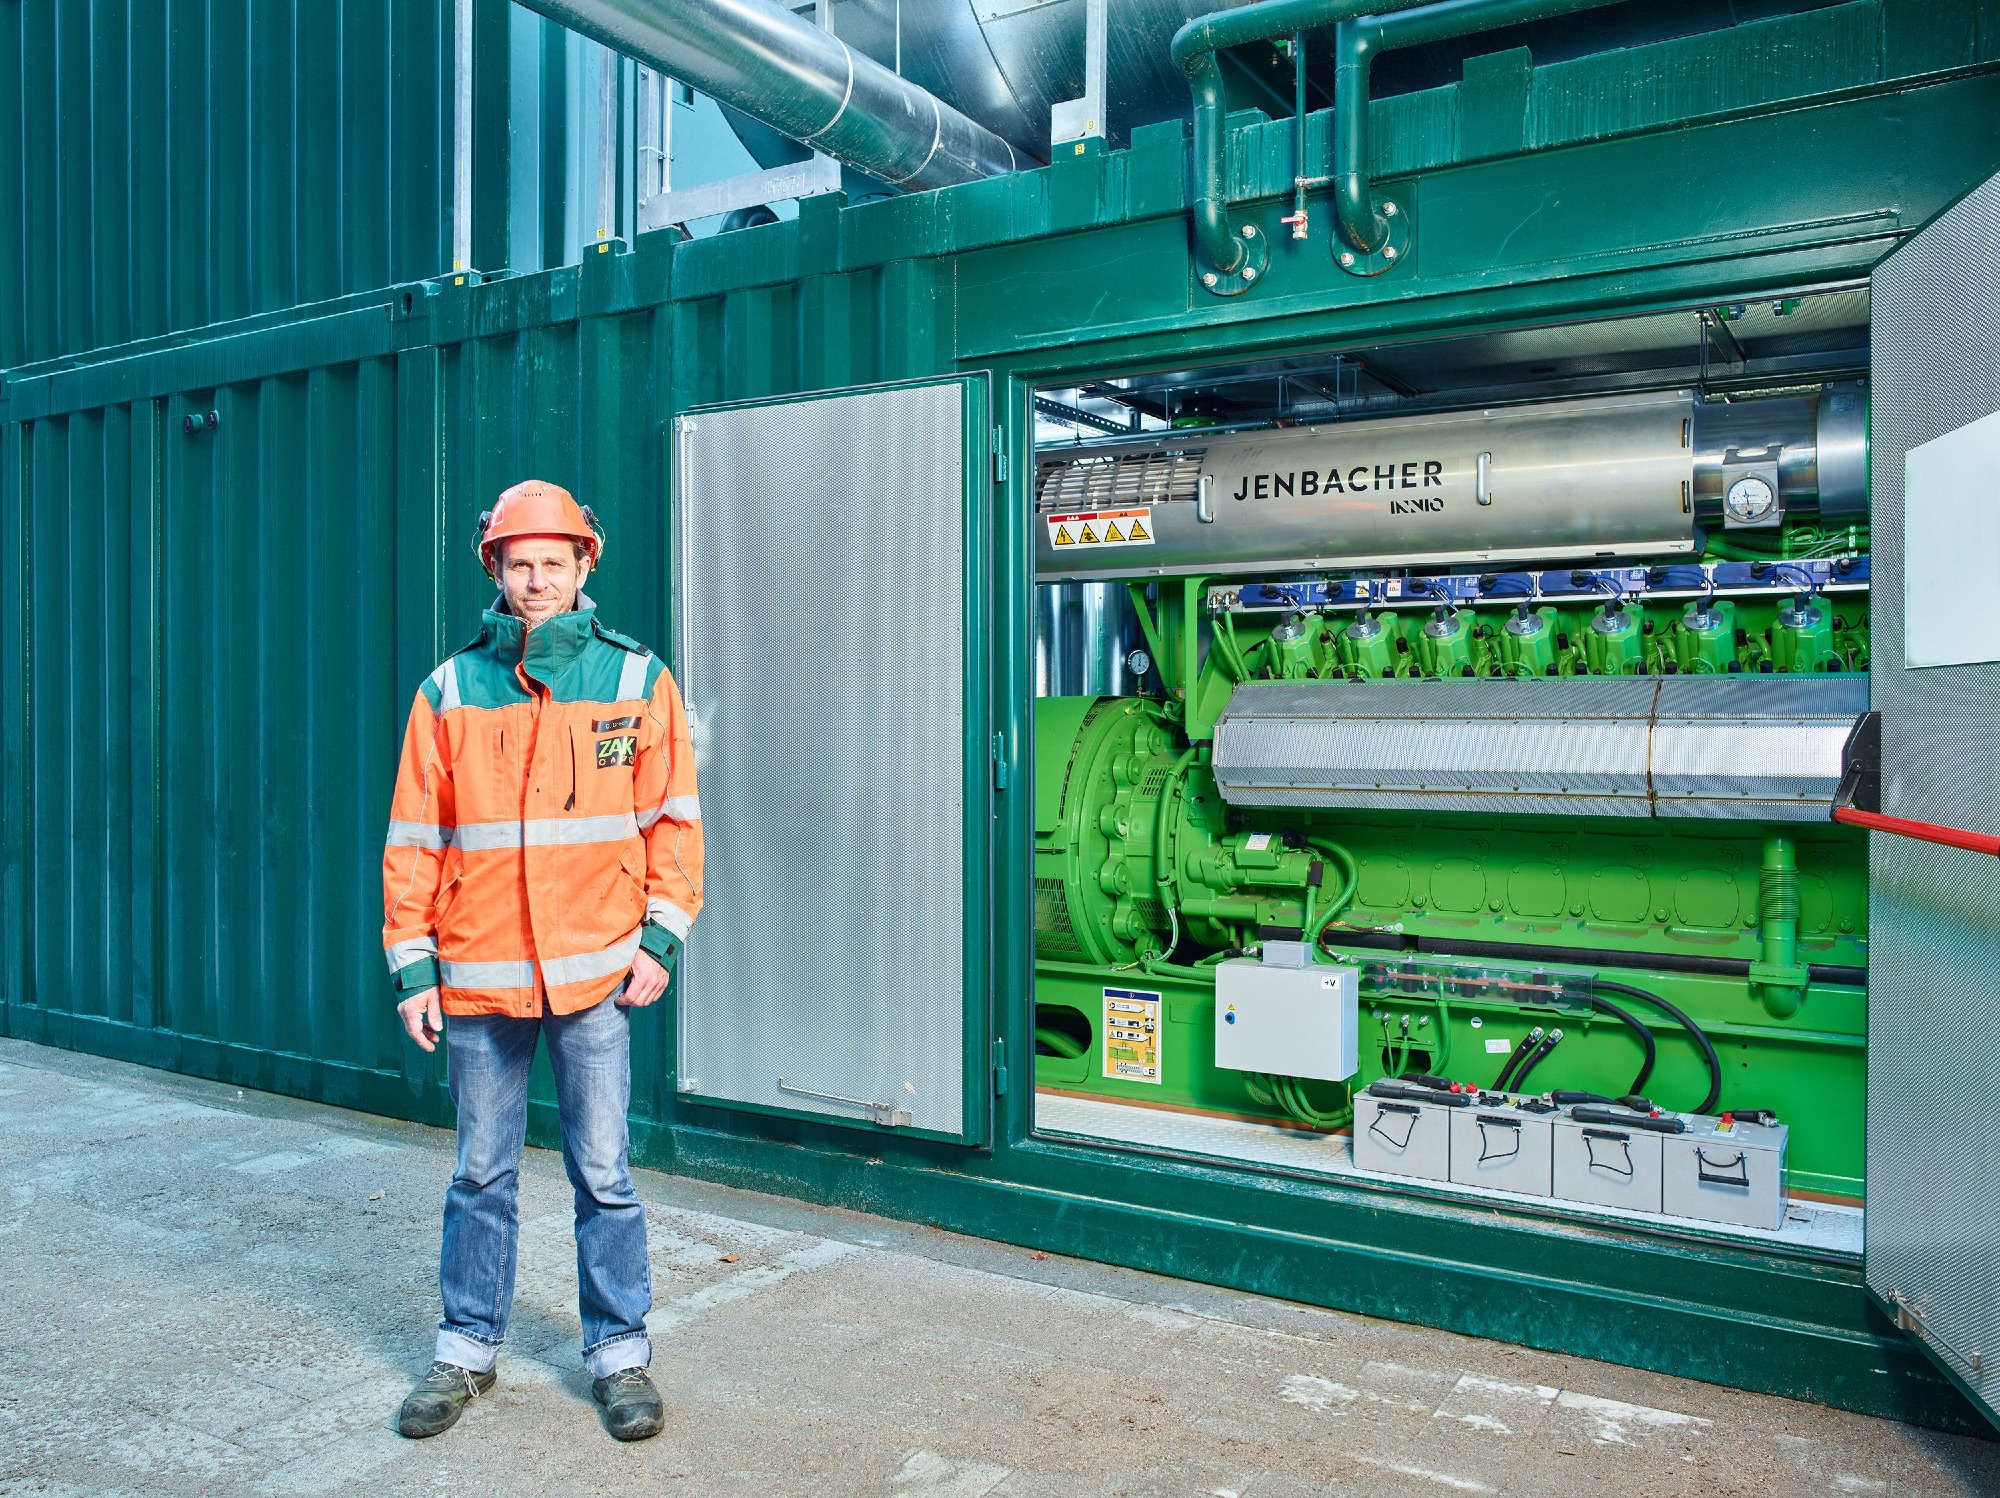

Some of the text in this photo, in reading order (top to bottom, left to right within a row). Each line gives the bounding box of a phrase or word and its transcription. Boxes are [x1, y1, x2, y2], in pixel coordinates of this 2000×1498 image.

[1088, 120, 1094, 130] 9
[1077, 144, 1083, 154] 9
[598, 229, 606, 237] 10
[600, 244, 608, 252] 10
[1233, 460, 1443, 501] JENBACHER
[1390, 497, 1444, 515] INNIO
[598, 737, 635, 758] ZAK
[1325, 979, 1336, 987] +V
